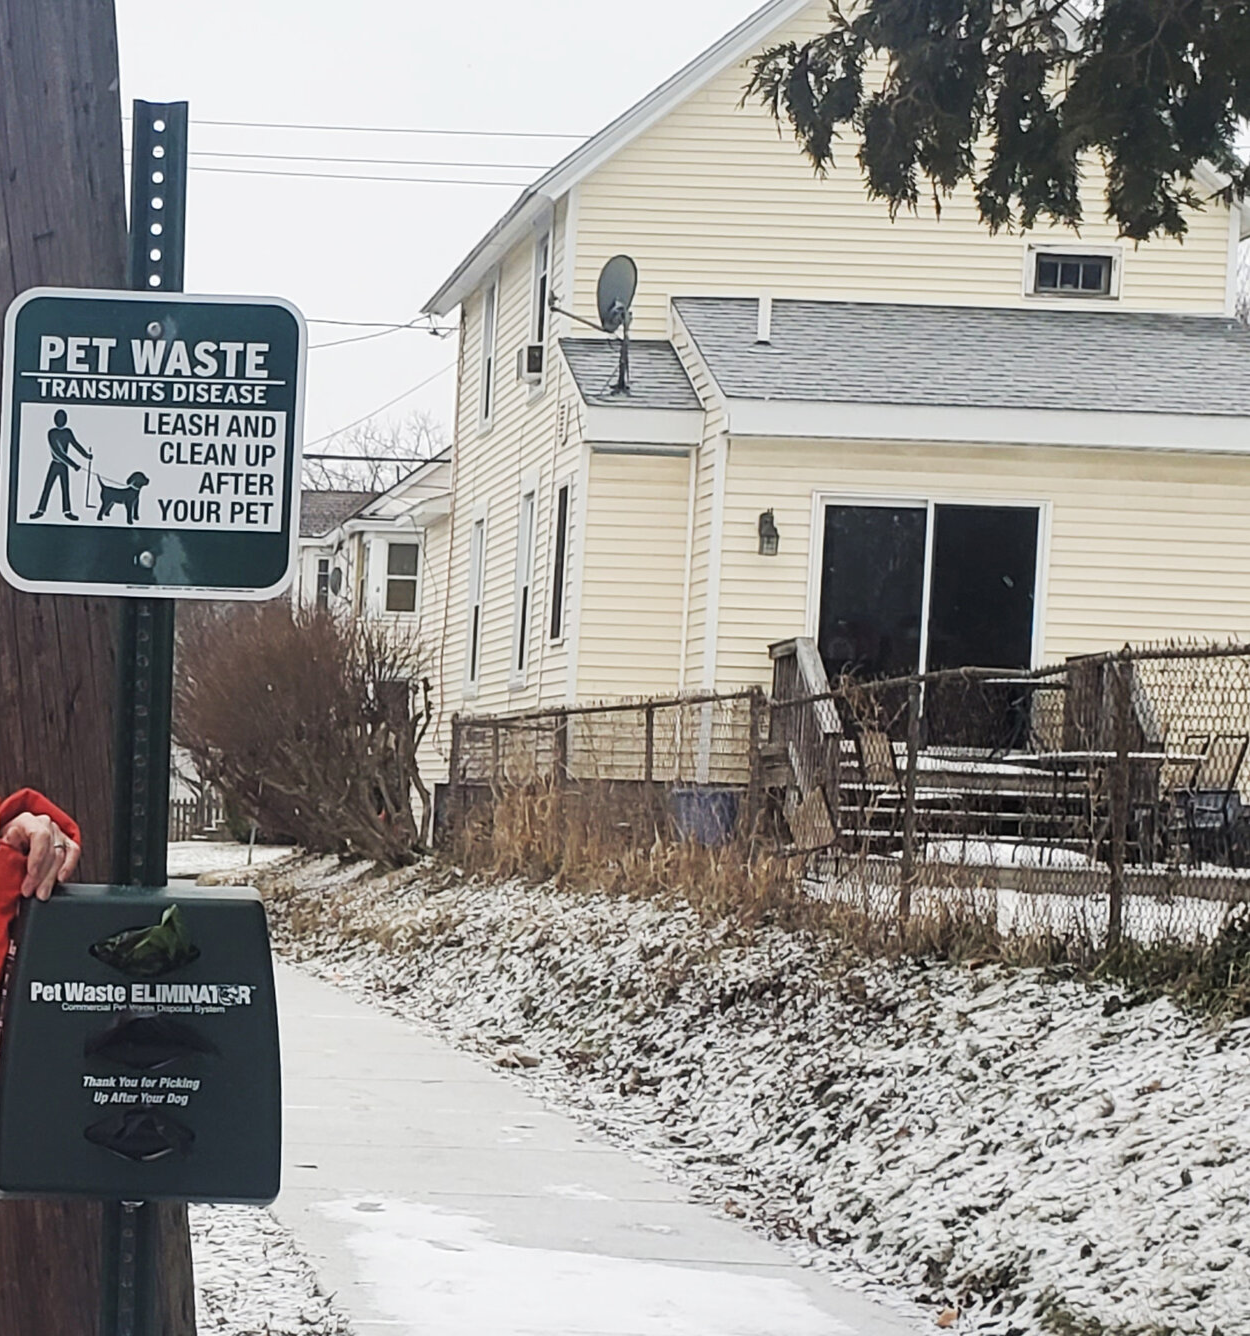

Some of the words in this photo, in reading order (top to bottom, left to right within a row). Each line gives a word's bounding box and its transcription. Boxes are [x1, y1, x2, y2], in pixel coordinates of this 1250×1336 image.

[39, 335, 117, 373] PET
[131, 339, 270, 378] WASTE
[37, 378, 166, 401] TRANSMITS
[172, 384, 267, 404] DISEASE
[143, 412, 219, 437] LEASH
[226, 415, 277, 438] AND
[159, 441, 237, 466] CLEAN
[244, 444, 276, 467] UP
[198, 472, 274, 496] AFTER
[158, 499, 221, 523] YOUR
[229, 501, 274, 525] PET
[30, 981, 62, 1002] Pet
[64, 981, 126, 1003] Waste
[61, 1002, 111, 1012] Commercial
[194, 1004, 226, 1015] System
[83, 1076, 116, 1088] Thank
[119, 1077, 138, 1088] You
[140, 1077, 157, 1089] for
[159, 1077, 201, 1092] Picking
[93, 1092, 109, 1105] Up
[110, 1092, 138, 1103] After
[140, 1092, 165, 1104] Your
[166, 1093, 189, 1107] Dog
